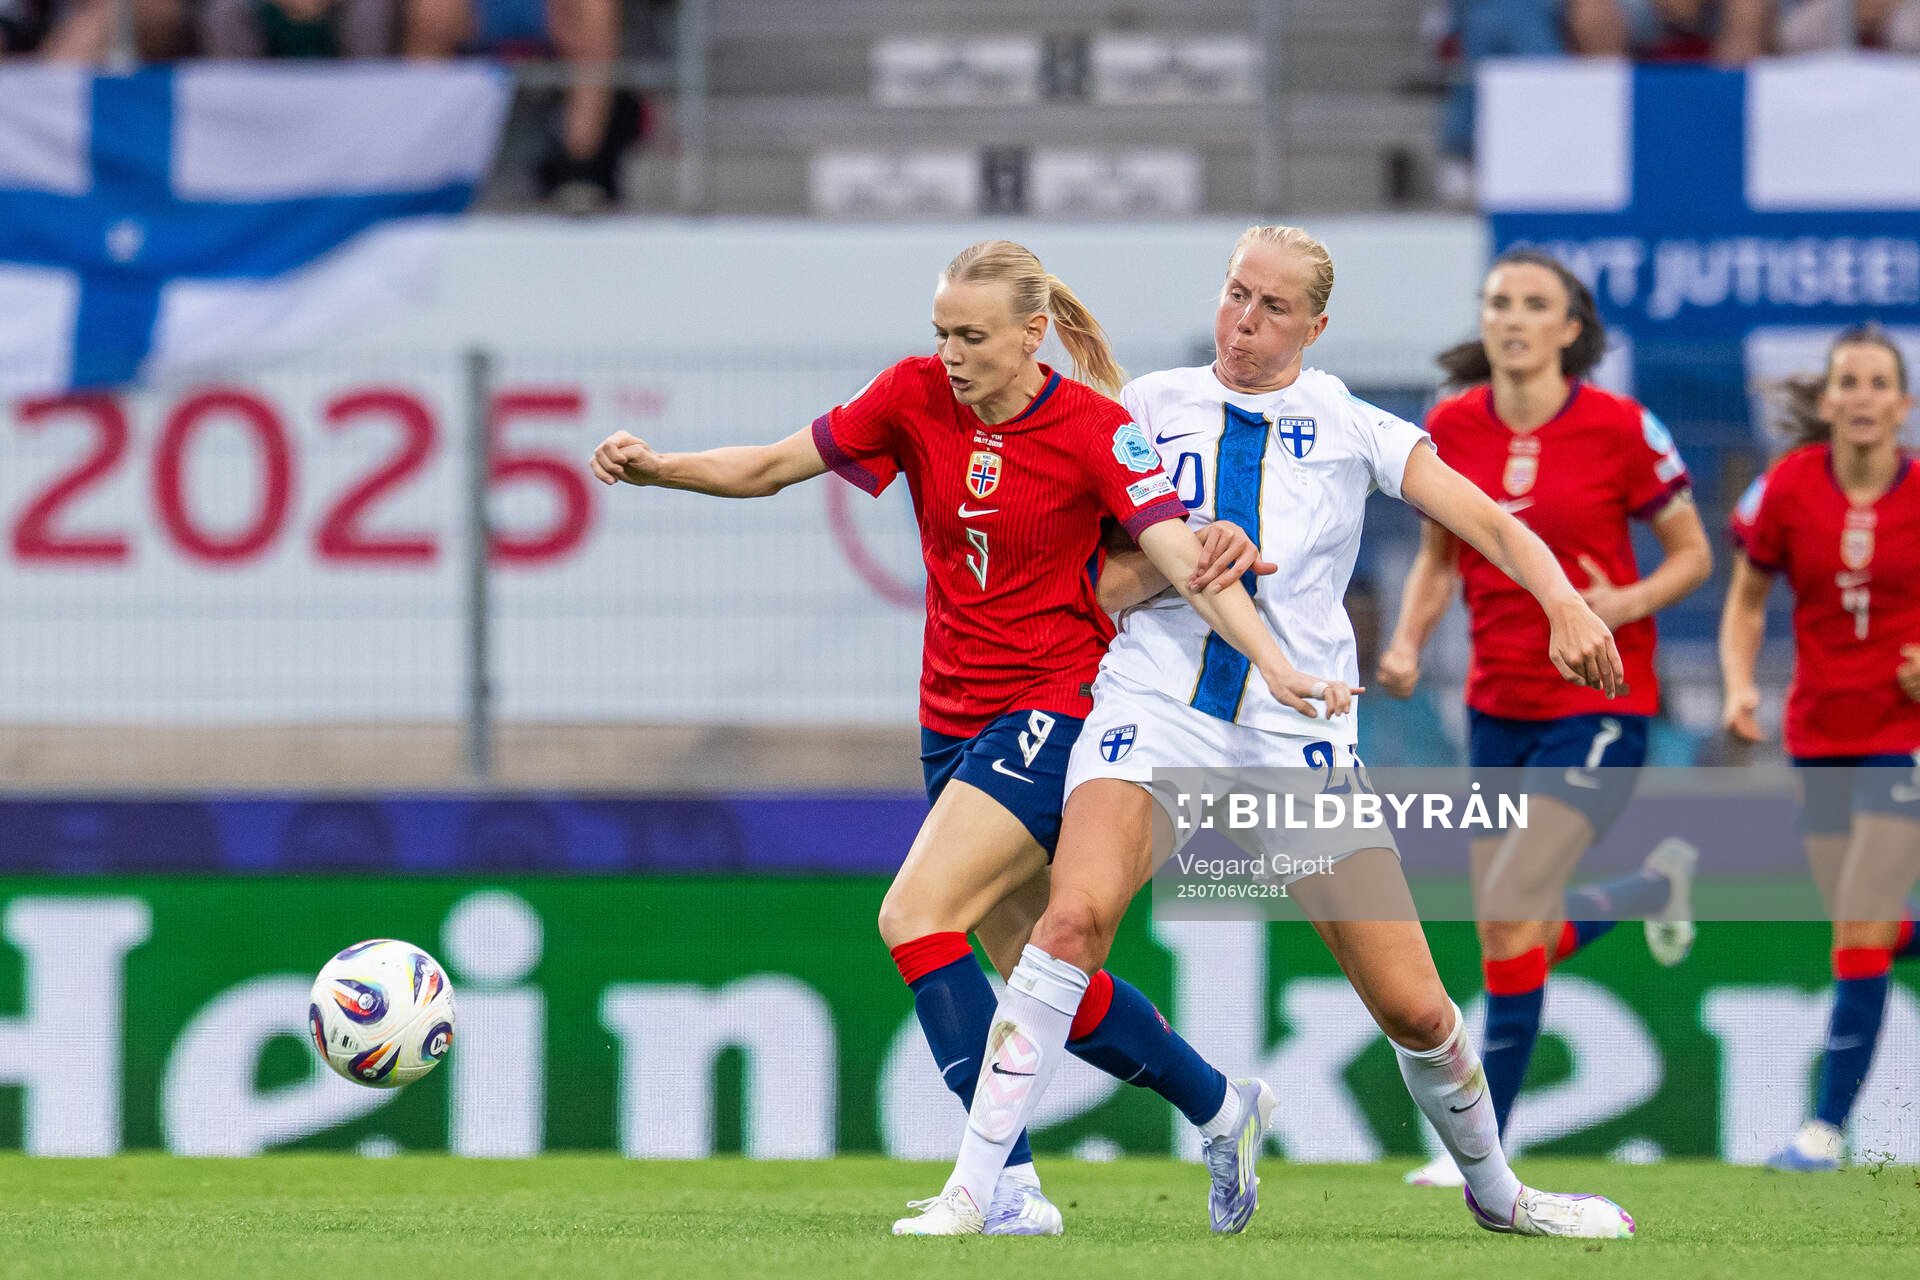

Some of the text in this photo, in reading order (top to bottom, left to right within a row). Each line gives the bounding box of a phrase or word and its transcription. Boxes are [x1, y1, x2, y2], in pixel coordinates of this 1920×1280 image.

[10, 384, 600, 568] 2025
[1018, 709, 1056, 768] 9
[1586, 717, 1622, 769] 7
